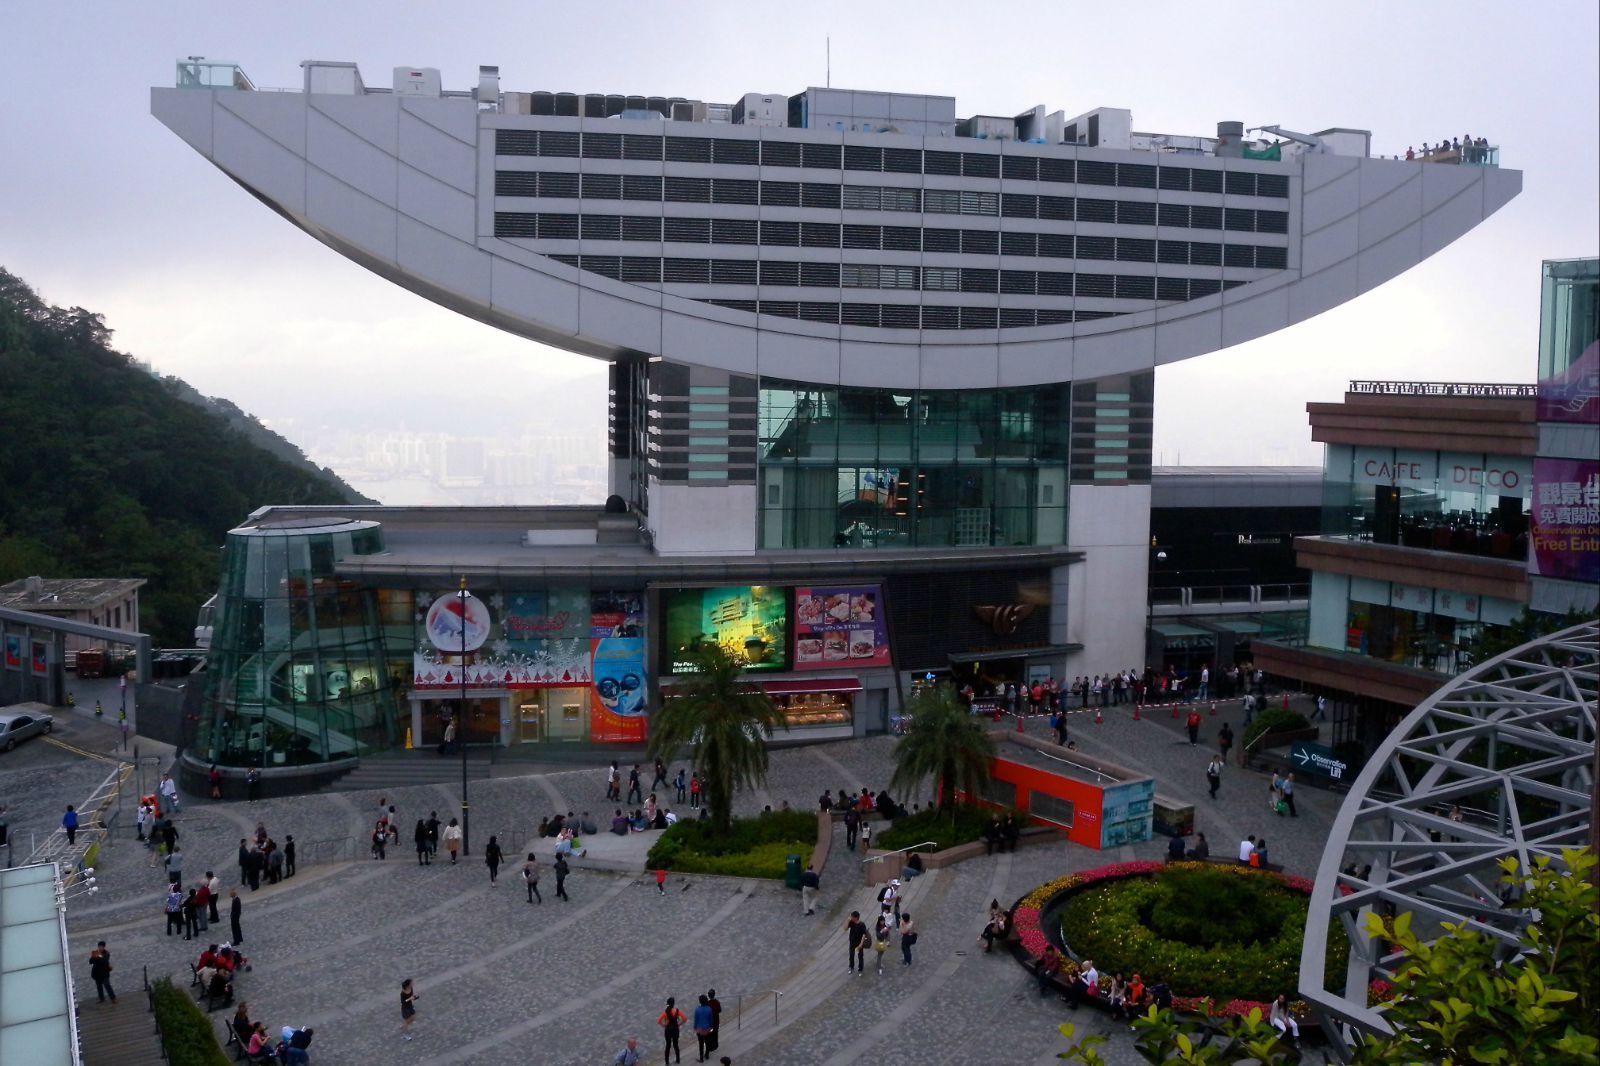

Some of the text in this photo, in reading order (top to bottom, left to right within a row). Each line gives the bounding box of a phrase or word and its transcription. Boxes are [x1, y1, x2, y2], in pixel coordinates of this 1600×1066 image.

[1365, 460, 1519, 488] CAFE DECO
[1534, 526, 1585, 535] Observation
[1536, 537, 1567, 551] Free
[1311, 753, 1346, 770] Observation
